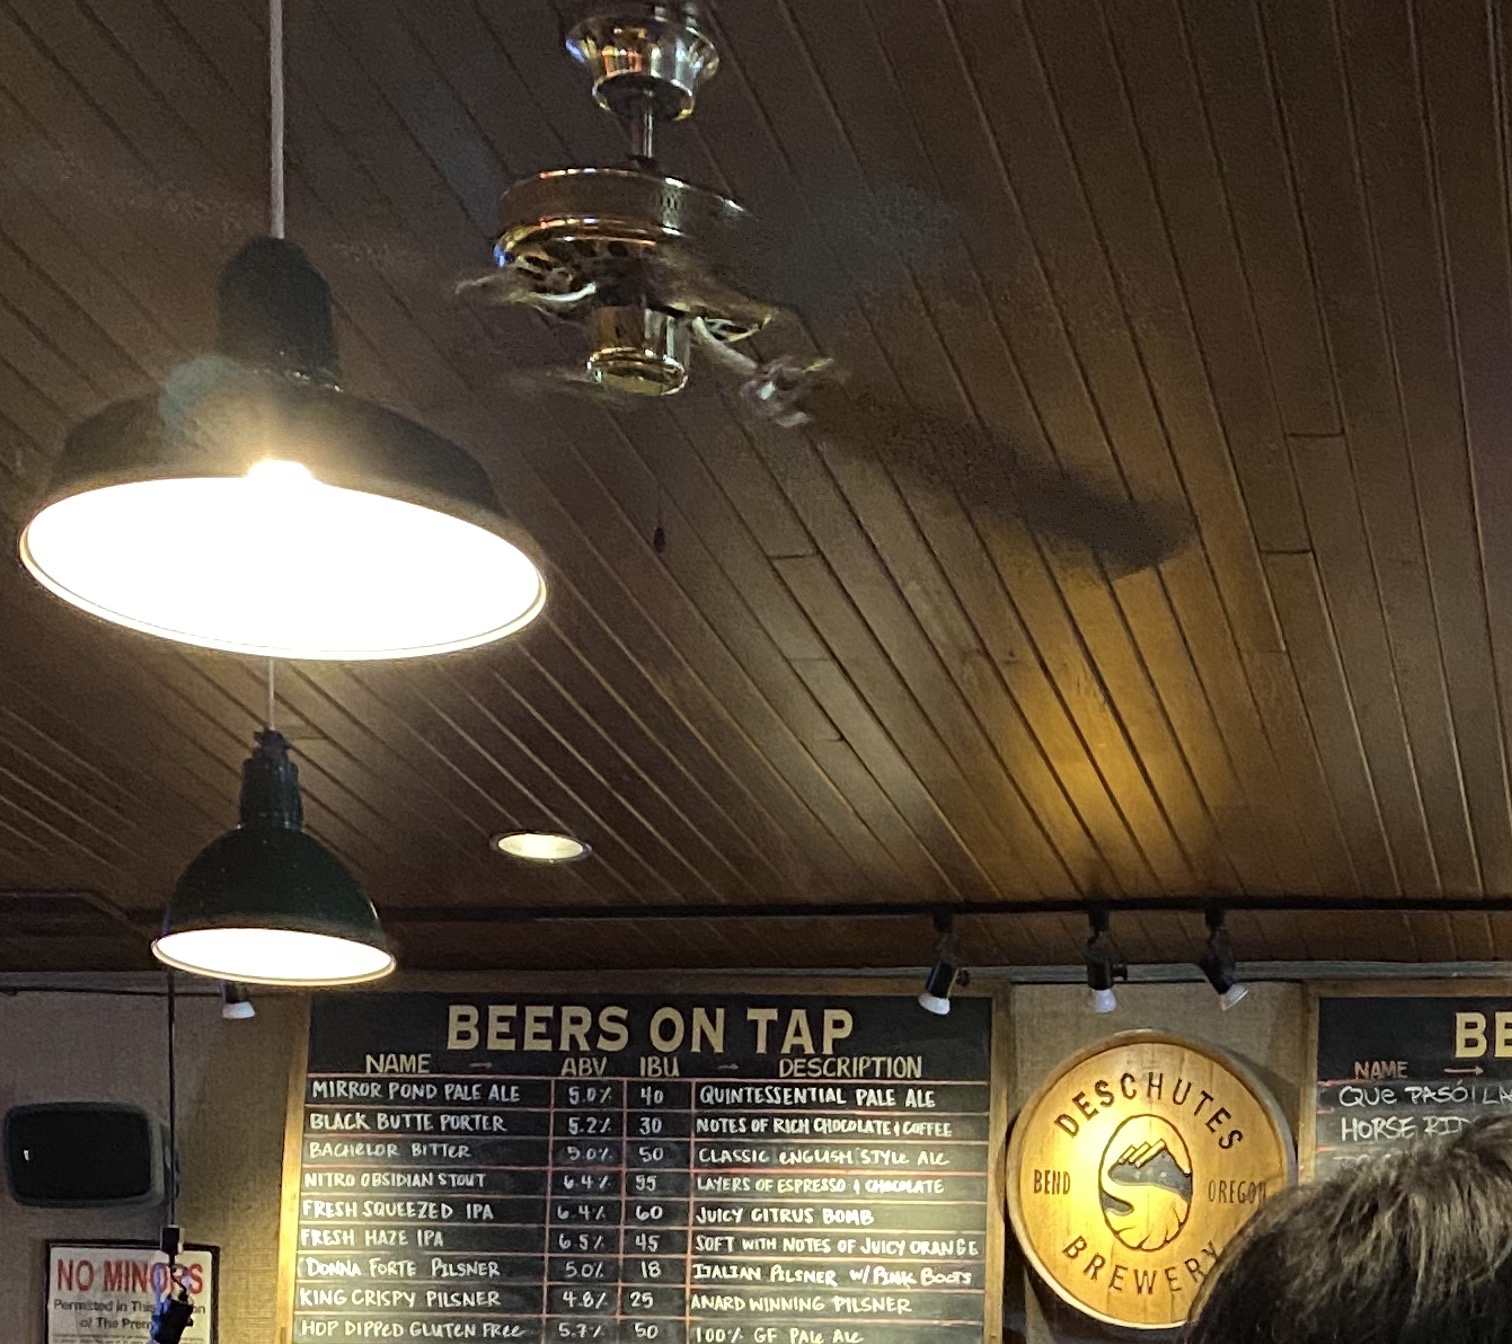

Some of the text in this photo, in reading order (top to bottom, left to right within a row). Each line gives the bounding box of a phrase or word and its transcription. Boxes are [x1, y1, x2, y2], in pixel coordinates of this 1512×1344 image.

[446, 1004, 854, 1055] BEERS ON TAP
[365, 1053, 923, 1080] NAME ABV IBU DESCRIPTION
[1353, 1060, 1408, 1080] NAME
[312, 1080, 936, 1108] MIRROR POND PALE ALE 5.0% 40 QUINTESSENTIAL PALE ALE
[1053, 1071, 1244, 1151] DESCHUTES
[310, 1112, 953, 1138] BLACK BUTTE PORTER 5.2% 30 NOTES OF RICH CHOCOLATE COFFEE
[1340, 1115, 1417, 1142] HORSE
[639, 1146, 664, 1164] 50
[698, 1148, 771, 1166] CLASSIC
[304, 1172, 356, 1187] NITRO
[360, 1172, 433, 1188] OBSIDIAN
[438, 1172, 486, 1188] STOUT
[696, 1177, 750, 1192] LAYERS
[755, 1178, 773, 1192] OF
[777, 1177, 846, 1193] ESPRESSO
[1033, 1168, 1267, 1204] BEND OREGON
[302, 1200, 357, 1218] FRESH
[362, 1201, 453, 1220] SQUEEZED
[466, 1203, 494, 1220] IPA
[634, 1205, 663, 1221] 60
[695, 1207, 744, 1224] JUICY
[750, 1207, 814, 1224] CITRUS
[822, 1208, 875, 1225] BOMB
[300, 1229, 355, 1247] FRESH
[364, 1229, 408, 1247] HAZE
[416, 1230, 444, 1248] IPA
[634, 1233, 658, 1251] 45
[695, 1235, 735, 1251] SOFT
[741, 1238, 777, 1251] WITH
[783, 1238, 831, 1253] NOTES
[836, 1238, 857, 1253] OF
[859, 1238, 906, 1256] JUICY
[909, 1239, 979, 1256] ORANGE
[57, 1258, 95, 1293] NO
[306, 1257, 361, 1276] DONNA
[368, 1258, 416, 1277] FORTE
[430, 1258, 501, 1277] PILSNER
[641, 1261, 662, 1279] 18
[692, 1263, 762, 1281] ITALIAN
[769, 1264, 838, 1287] PILSNER
[1062, 1235, 1225, 1295] BREWERY
[299, 1287, 348, 1306] KING
[351, 1289, 416, 1309] CRISPY
[426, 1289, 501, 1309] PILSNER
[629, 1290, 654, 1309] 25
[748, 1296, 825, 1313] WINNING
[833, 1295, 913, 1316] PILSNER
[96, 1316, 118, 1329] The
[301, 1320, 339, 1336] HOP
[634, 1322, 659, 1340] 50
[696, 1326, 744, 1343] 100%
[753, 1327, 778, 1344] GF
